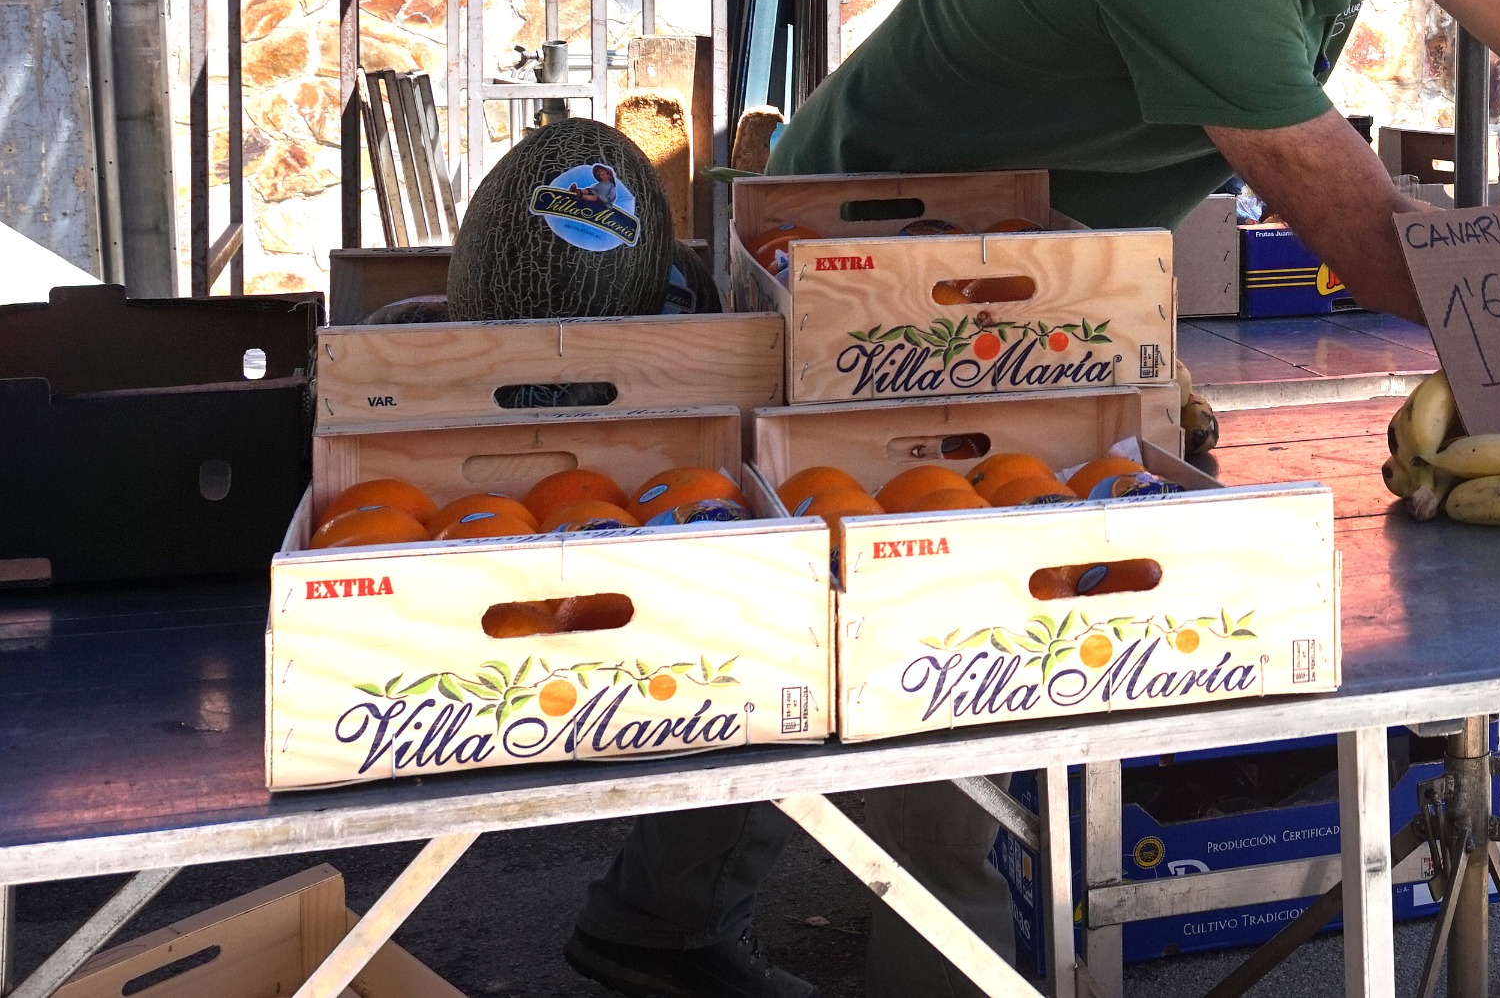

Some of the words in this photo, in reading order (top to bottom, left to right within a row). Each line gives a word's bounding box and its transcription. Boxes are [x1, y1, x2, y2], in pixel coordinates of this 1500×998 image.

[539, 190, 582, 215] Villa
[1255, 230, 1275, 238] Frutas
[814, 255, 876, 271] EXTRA
[836, 341, 947, 396] Villa
[949, 338, 1113, 390] María
[367, 395, 398, 407] VAR.
[872, 537, 951, 559] EXTRA
[305, 576, 394, 600] EXTRA
[900, 651, 1041, 722] Villa
[1047, 637, 1259, 708] María
[334, 698, 496, 775] Villa
[502, 683, 741, 759] María
[1206, 833, 1277, 853] PRODUCCIÓN
[1183, 918, 1238, 936] CULTIVO
